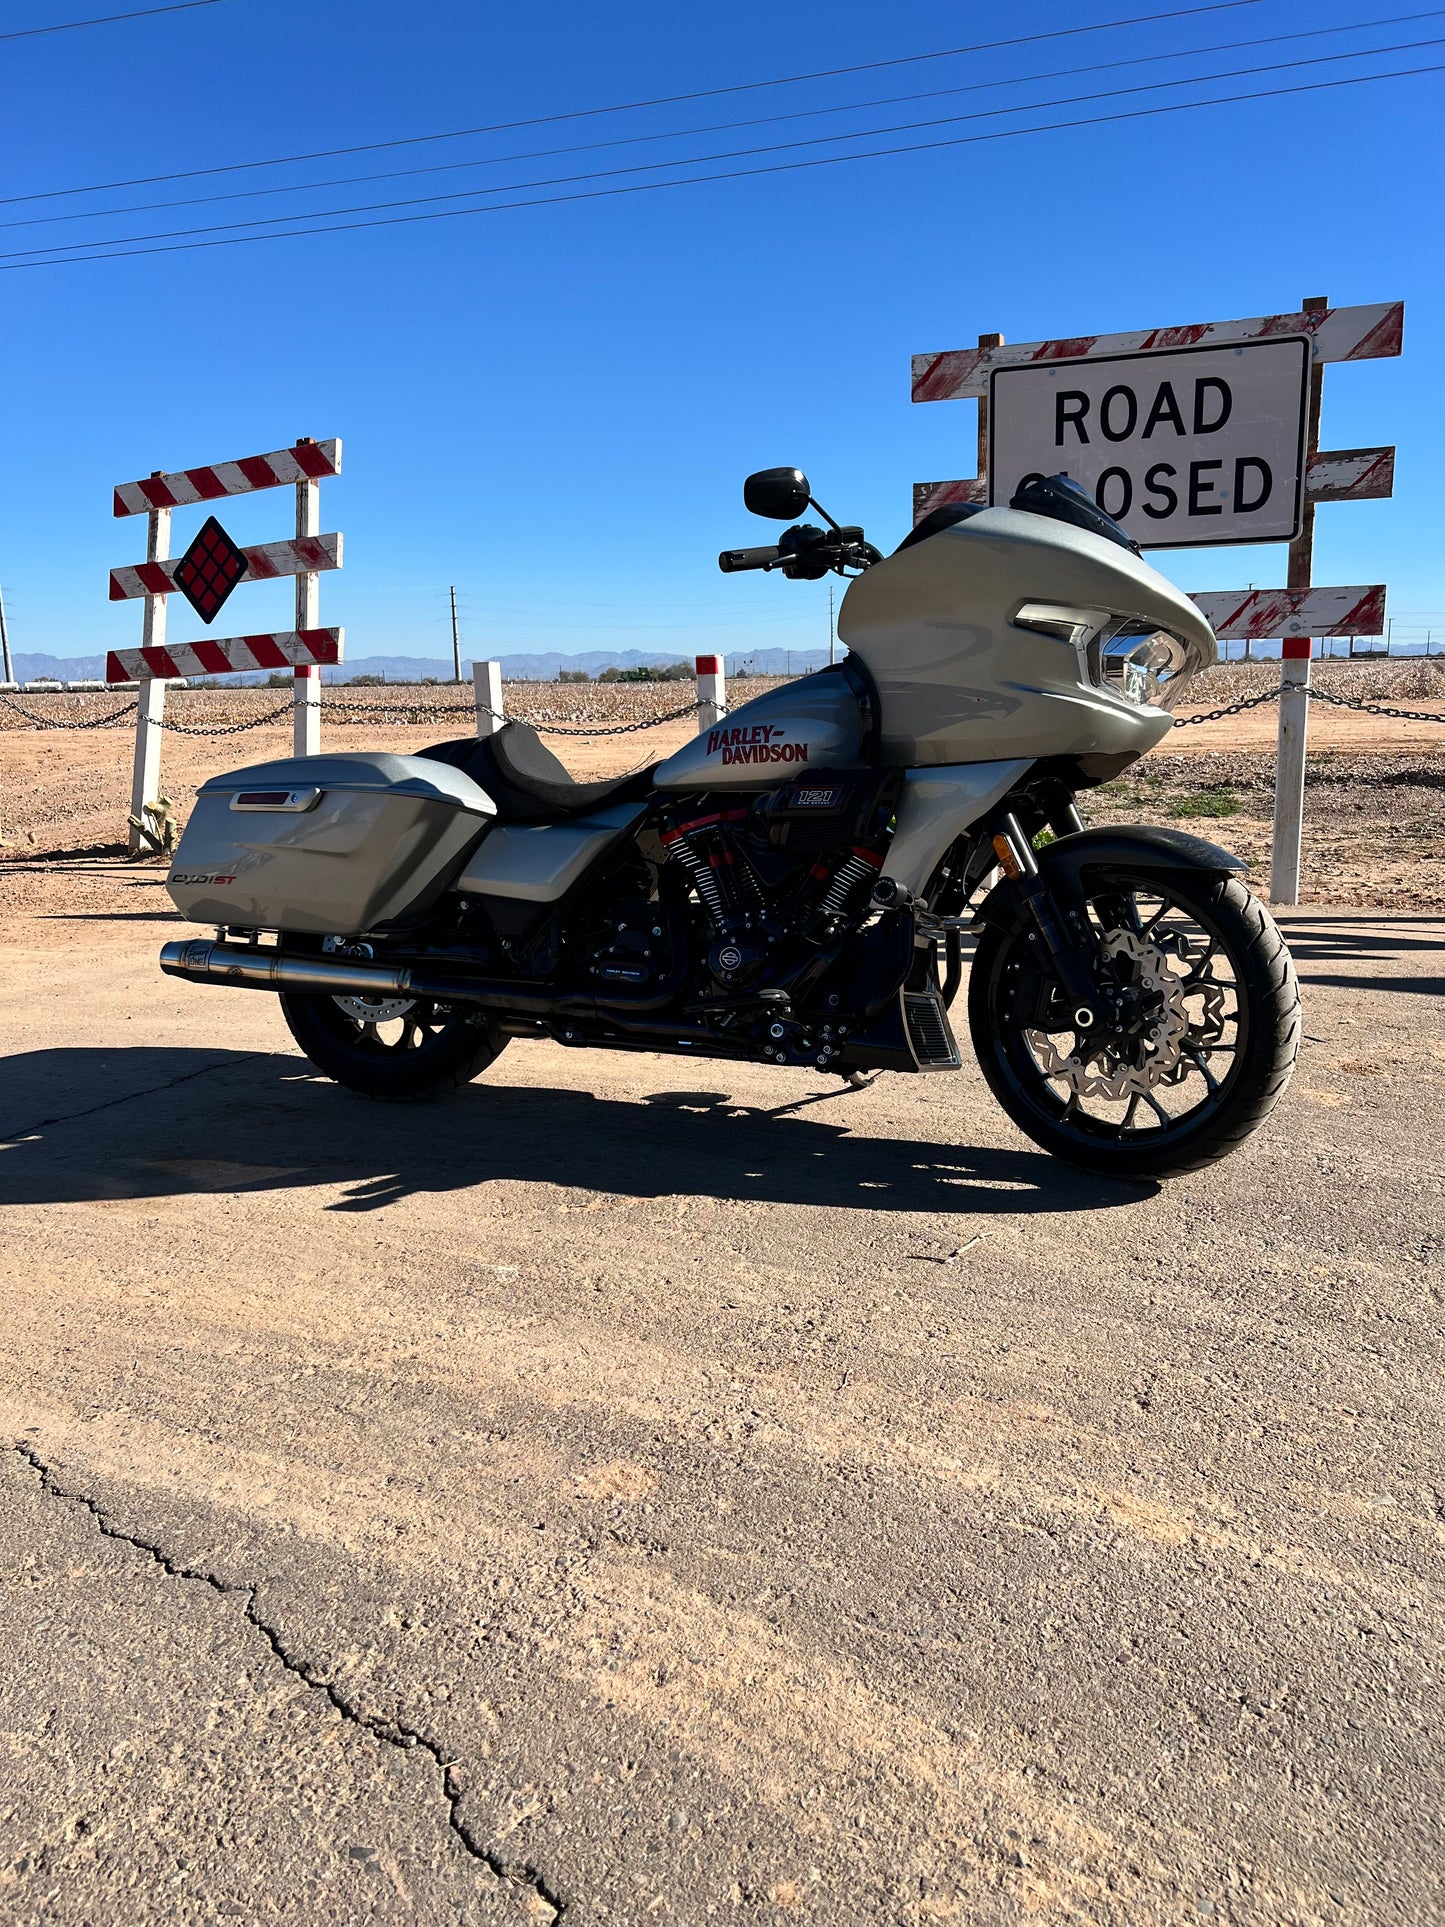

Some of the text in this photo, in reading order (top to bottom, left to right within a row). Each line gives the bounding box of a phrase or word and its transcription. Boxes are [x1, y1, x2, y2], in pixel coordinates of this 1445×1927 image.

[1055, 377, 1232, 446] ROAD
[1016, 456, 1273, 521] OSED
[706, 725, 785, 756] HARLEY-
[722, 743, 809, 765] DAVIDSON
[798, 790, 833, 801] 121
